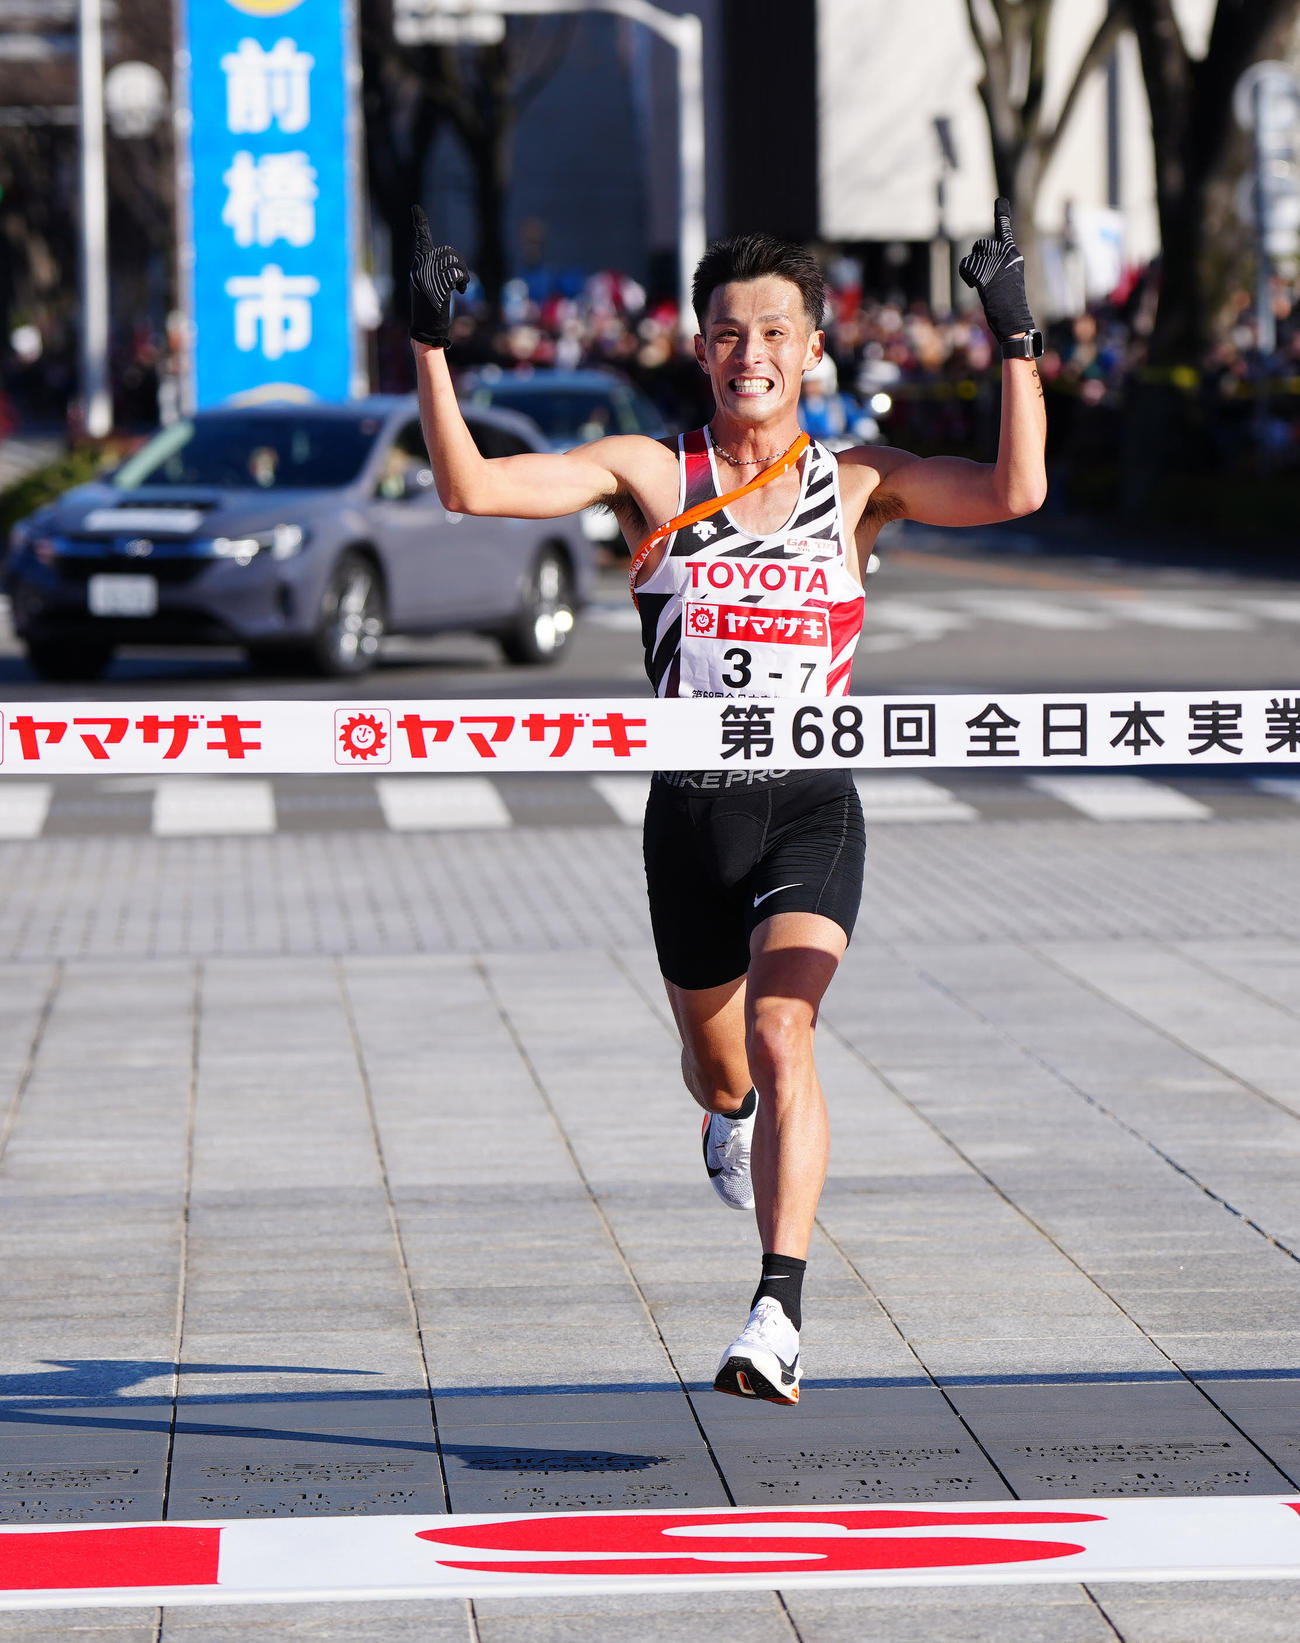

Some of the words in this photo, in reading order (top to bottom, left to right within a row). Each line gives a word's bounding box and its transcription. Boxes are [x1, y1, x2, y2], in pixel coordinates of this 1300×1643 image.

[221, 37, 319, 360] 前橋市
[685, 562, 828, 595] TOYOTA
[724, 612, 824, 640] ヤマザキ
[9, 714, 262, 760] ヤマザキ
[396, 712, 647, 758] ヤマザキ
[656, 770, 722, 788] NIKE
